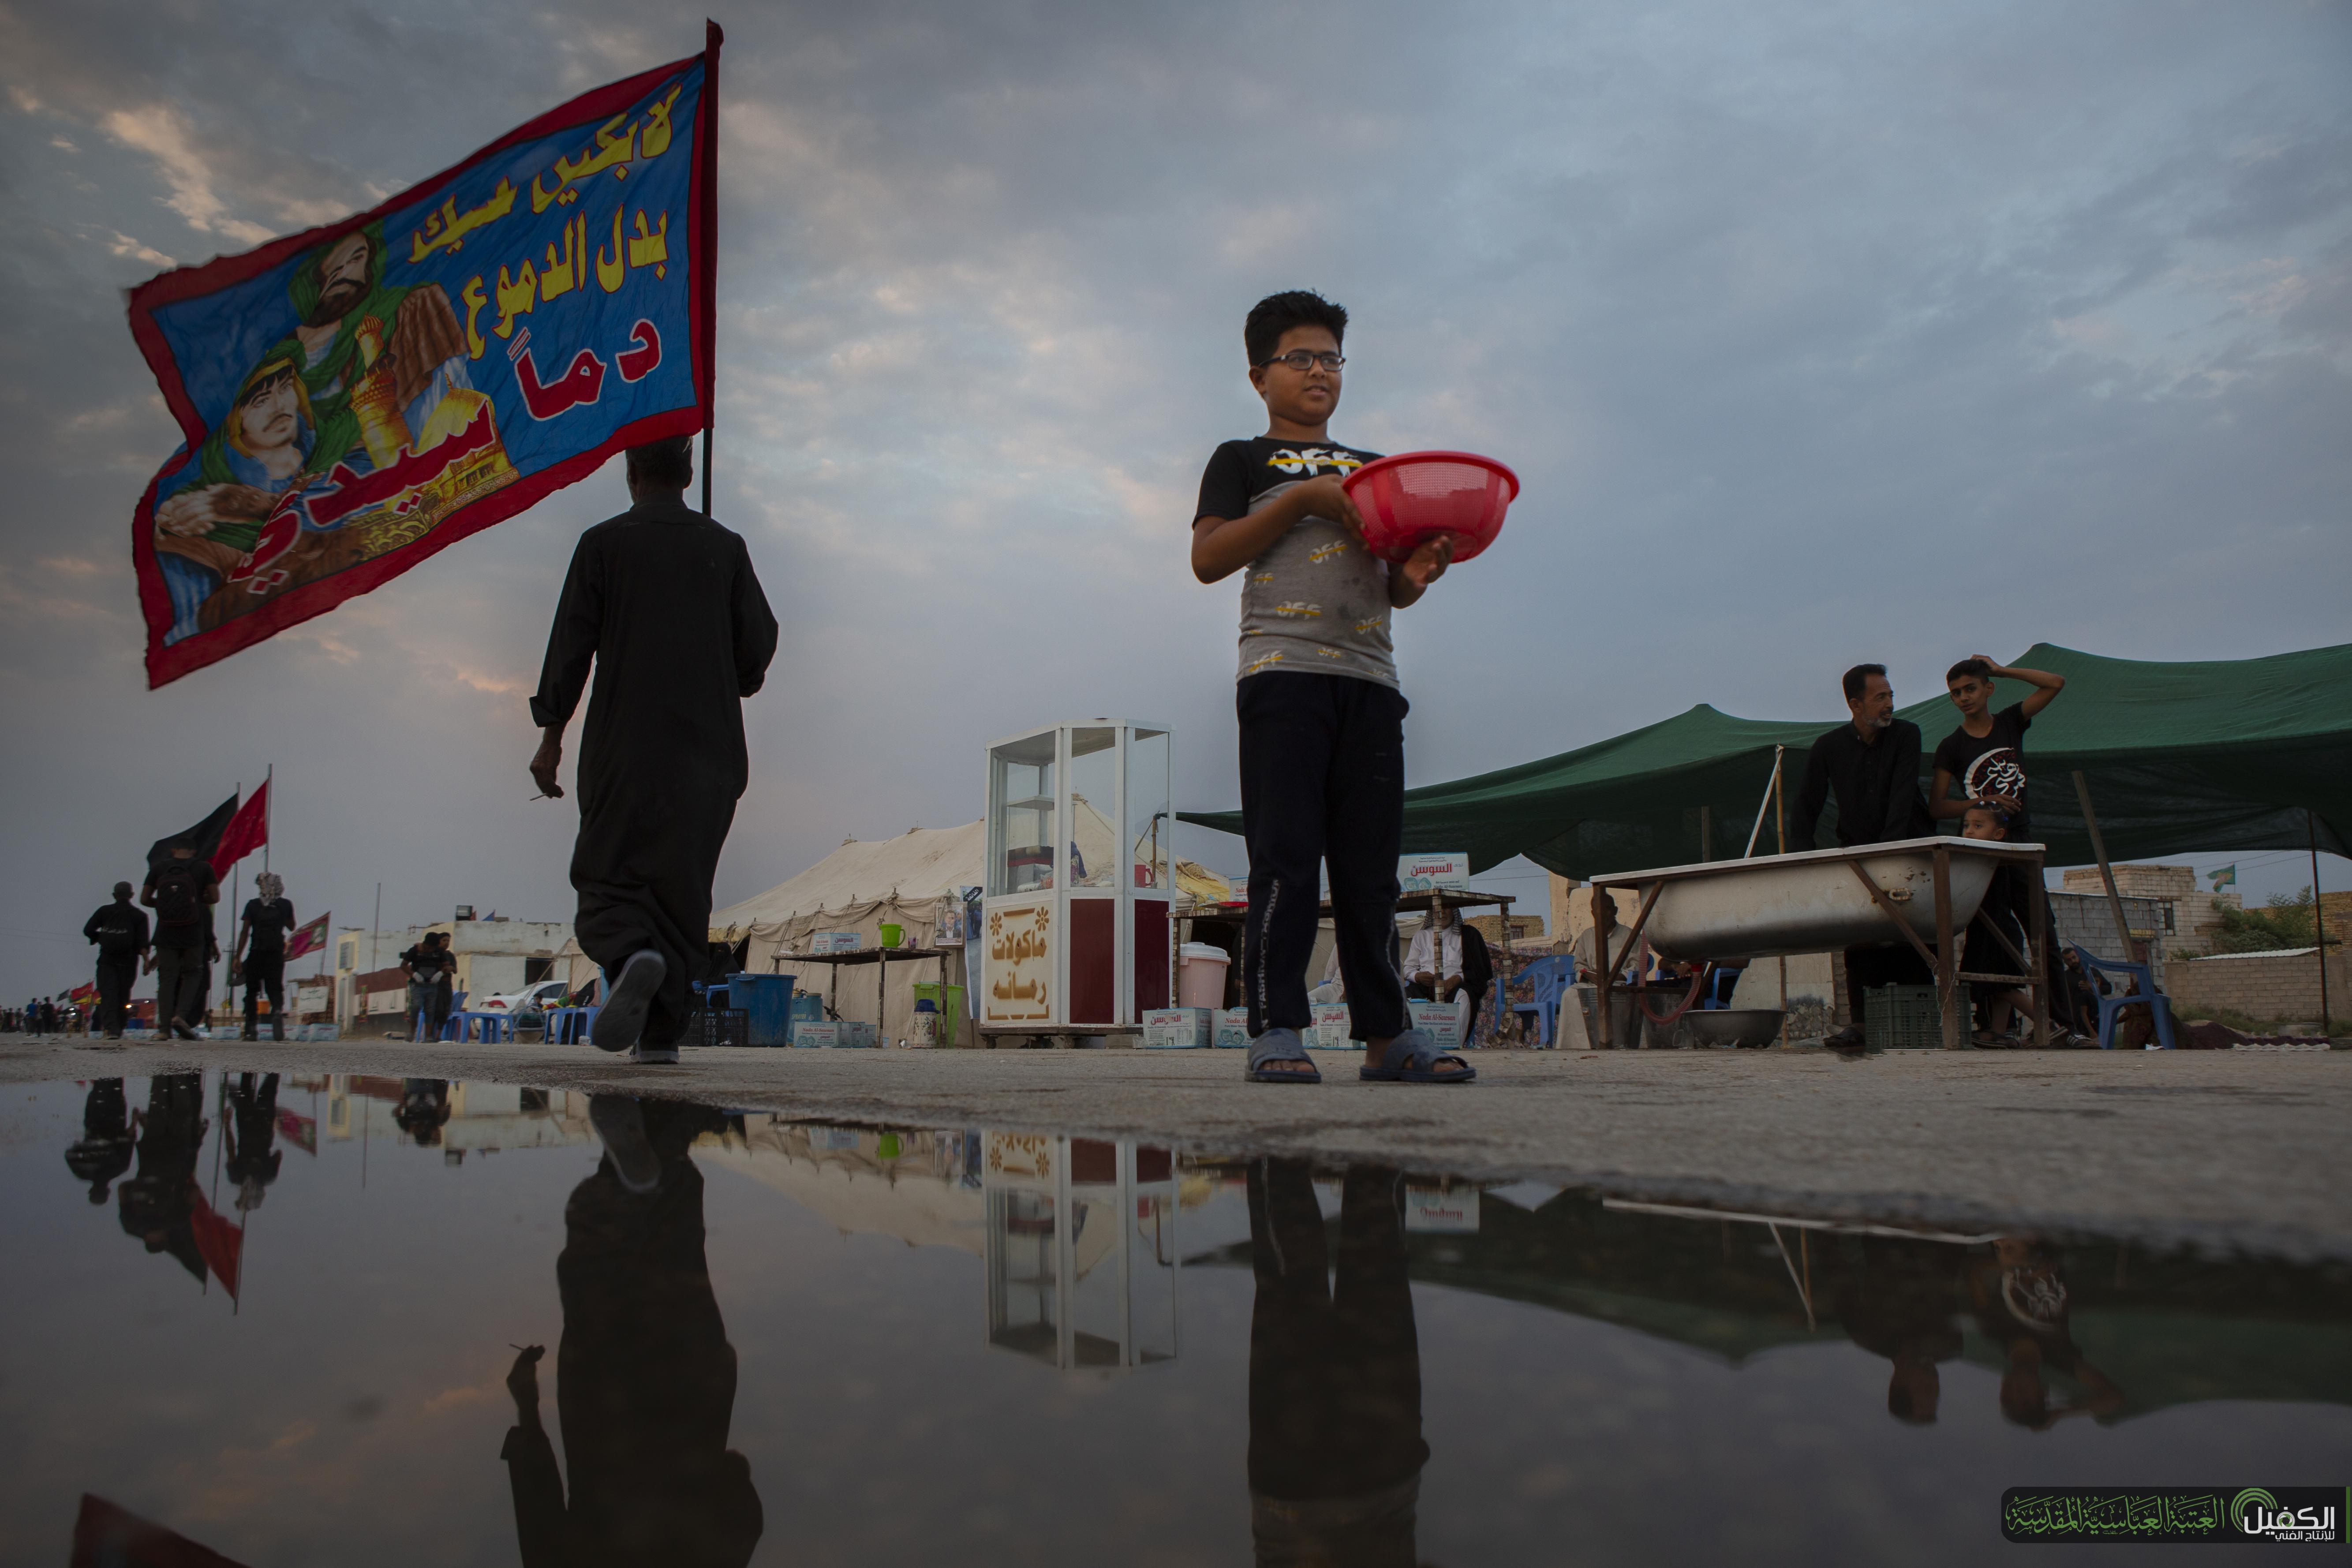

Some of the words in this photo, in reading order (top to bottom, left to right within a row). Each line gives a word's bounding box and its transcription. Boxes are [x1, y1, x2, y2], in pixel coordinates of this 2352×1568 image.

[595, 203, 669, 294] بدل
[460, 210, 587, 360] الدموع
[1267, 447, 1364, 478] OFF
[1309, 540, 1347, 564] OFF
[1275, 601, 1322, 620] OFF
[1411, 863, 1452, 877] السوسن
[992, 929, 1047, 966] ماكولات
[1322, 1011, 1344, 1022] السوسن
